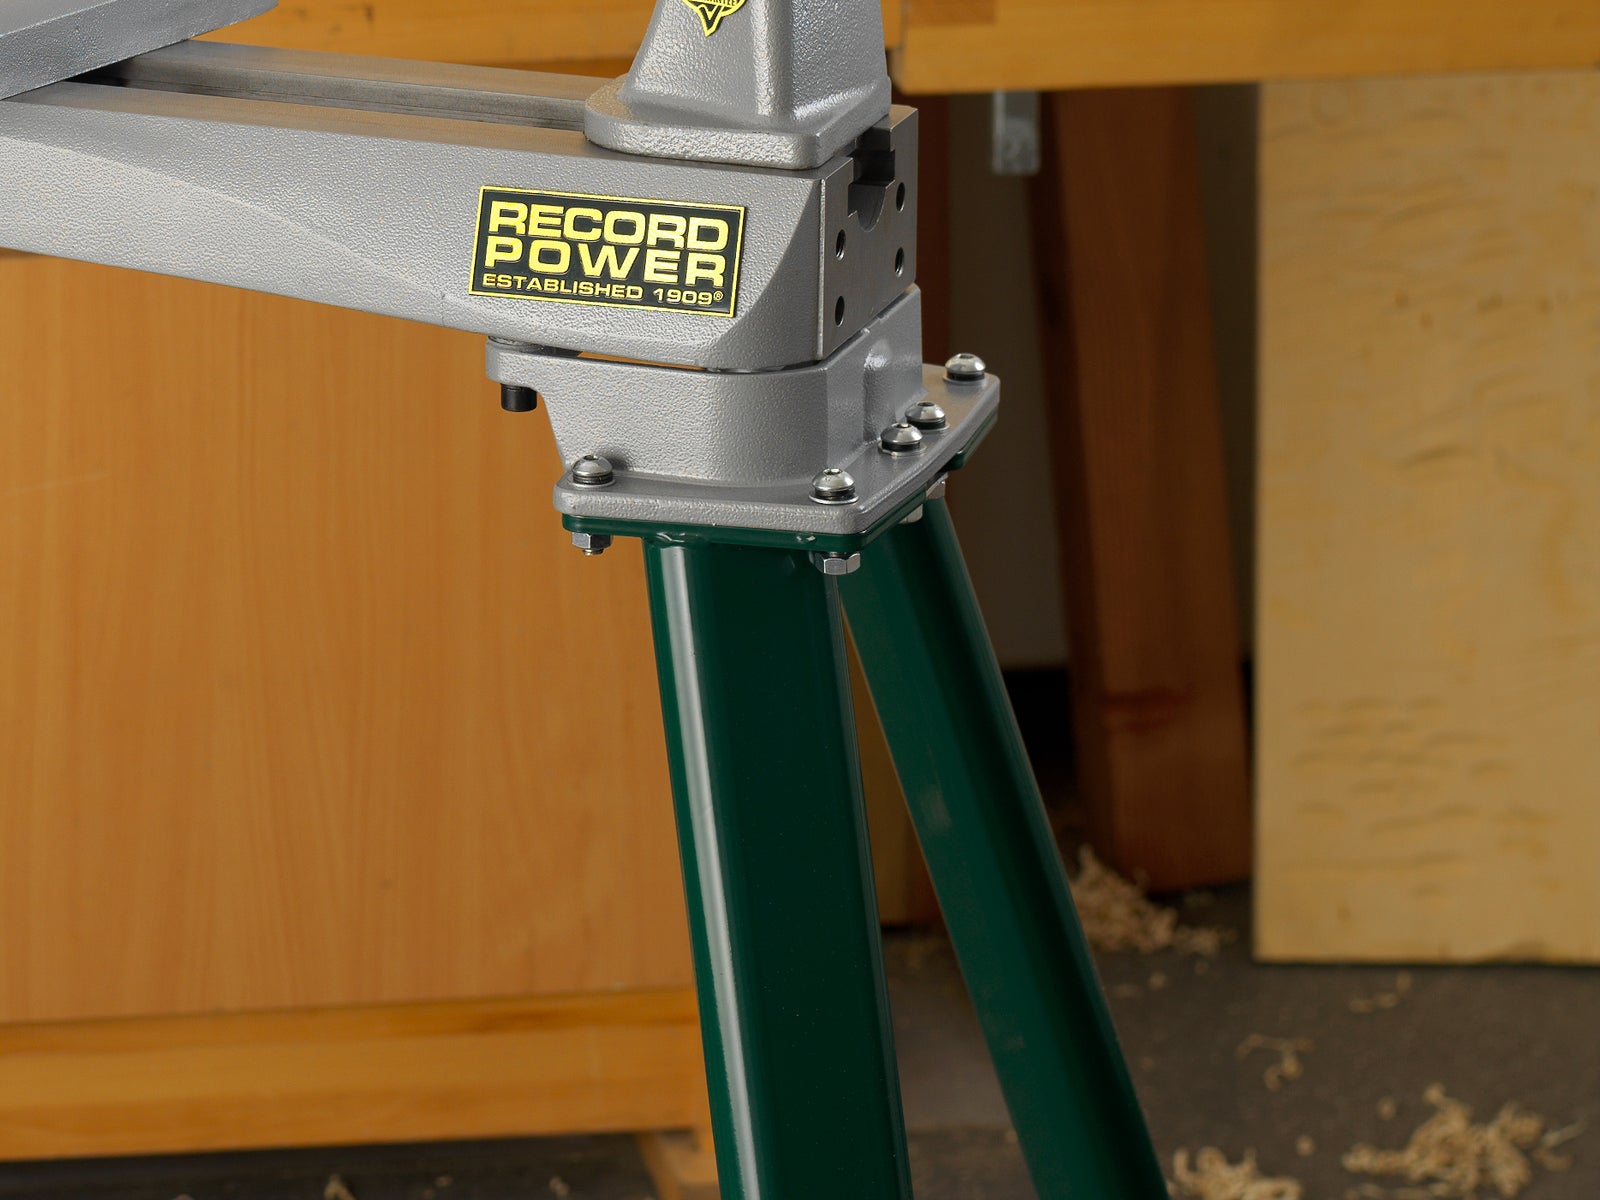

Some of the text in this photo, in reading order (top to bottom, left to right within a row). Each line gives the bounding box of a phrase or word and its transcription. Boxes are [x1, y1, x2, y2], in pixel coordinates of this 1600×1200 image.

[488, 200, 730, 252] RECORD
[482, 273, 644, 300] ESTABLISHED
[484, 235, 728, 288] POWER
